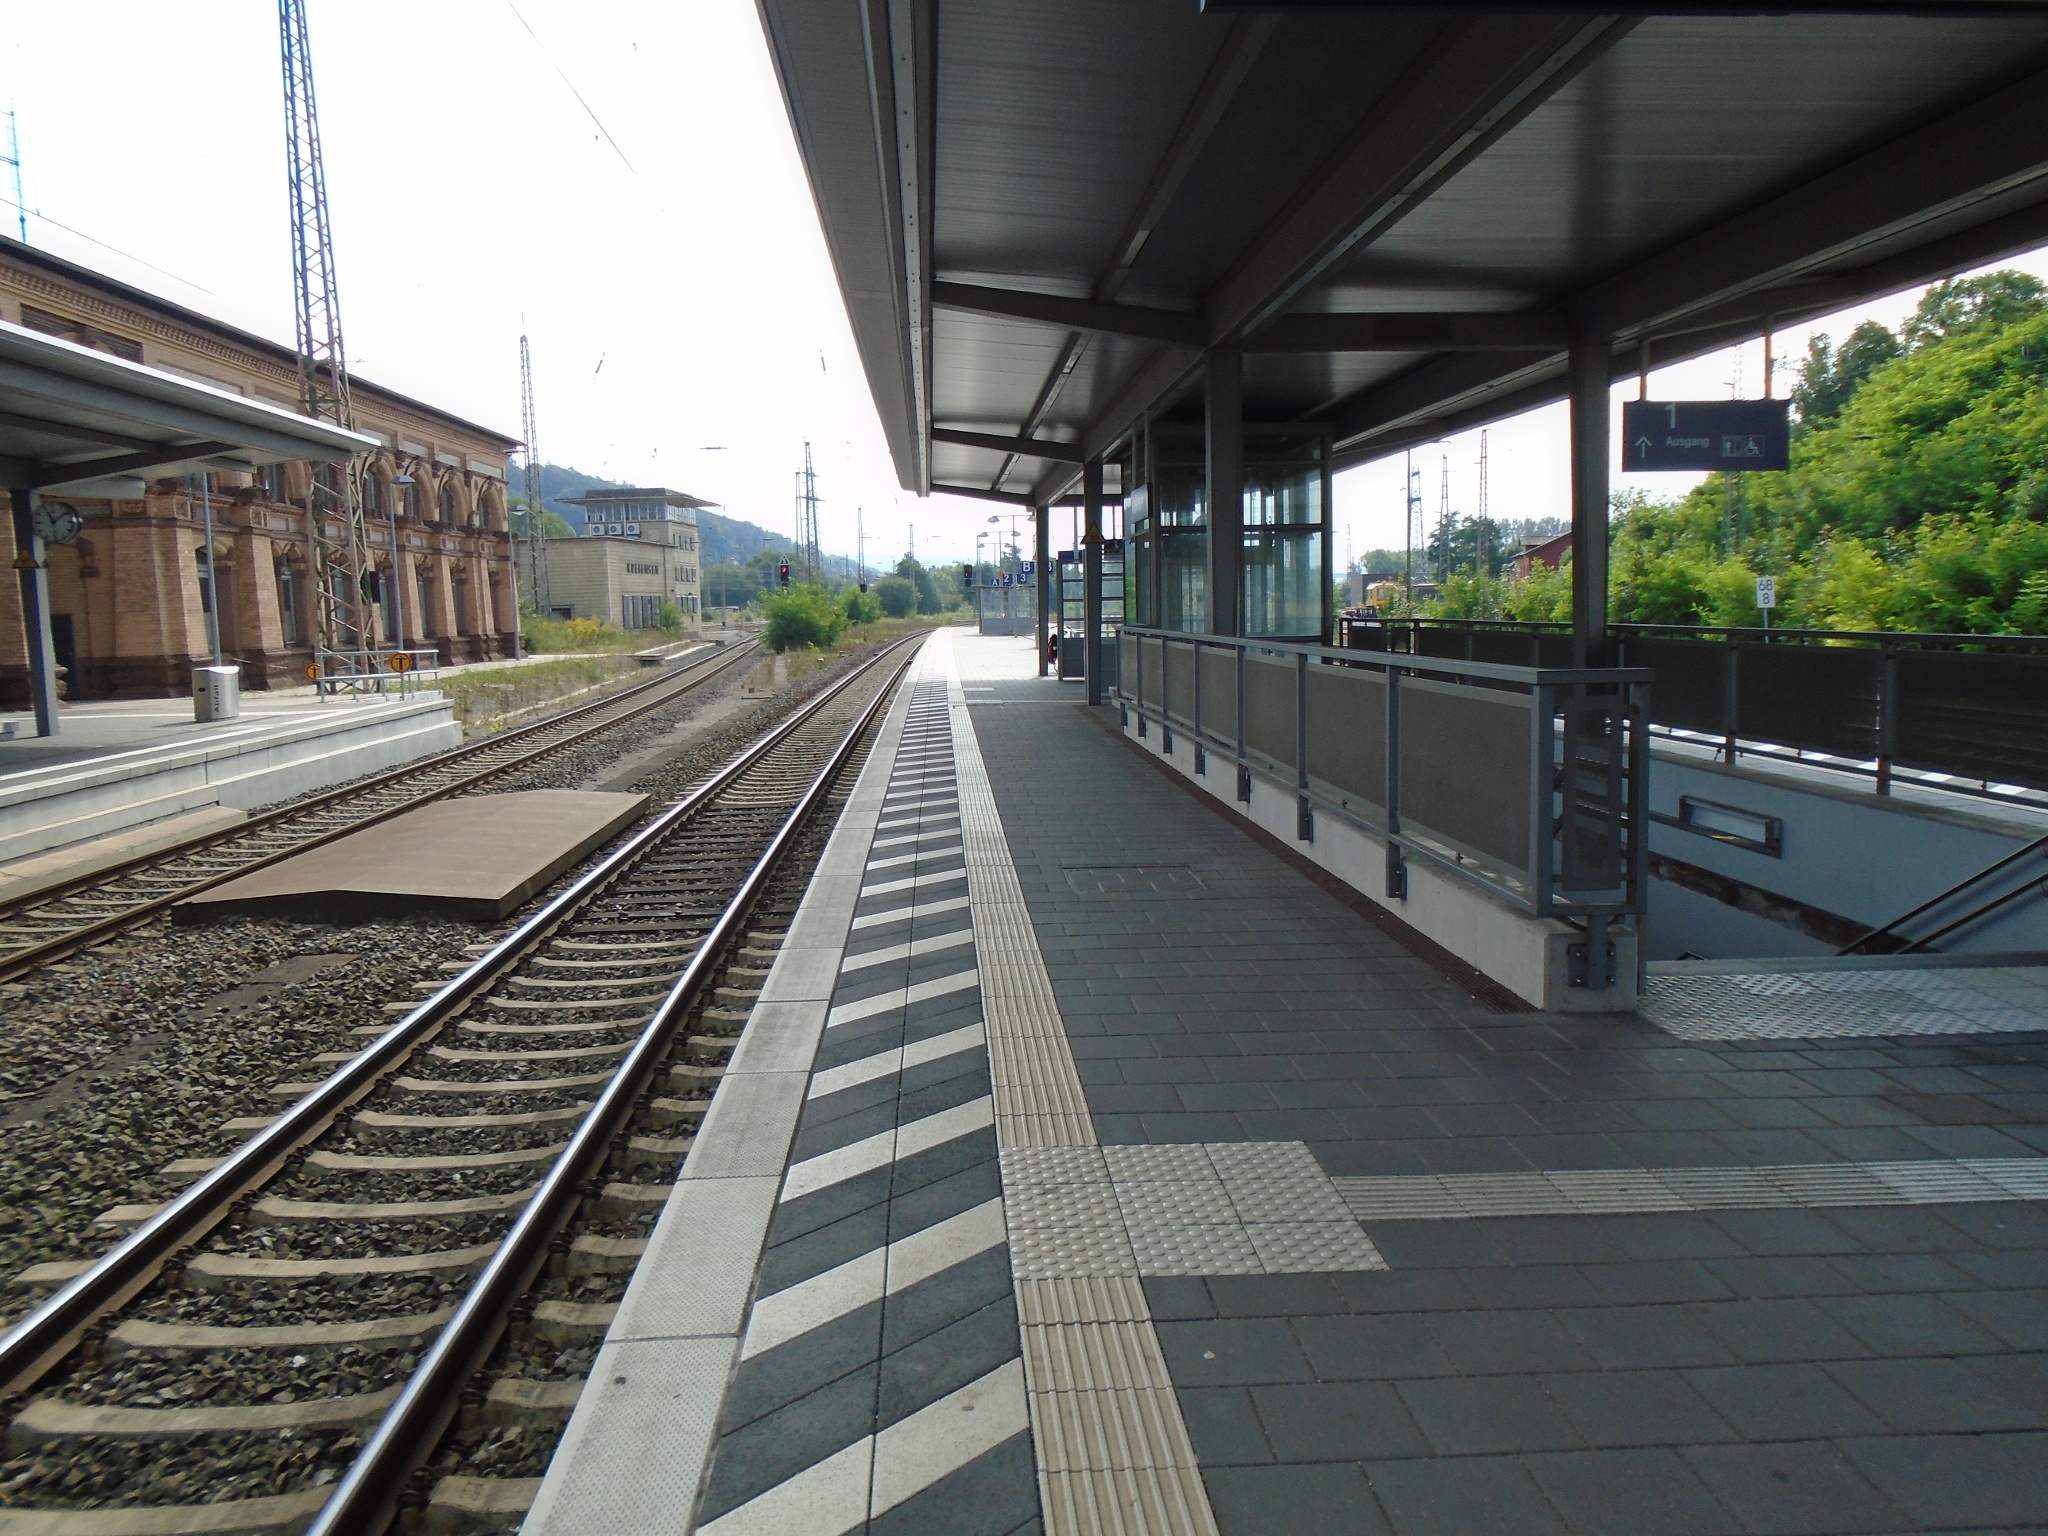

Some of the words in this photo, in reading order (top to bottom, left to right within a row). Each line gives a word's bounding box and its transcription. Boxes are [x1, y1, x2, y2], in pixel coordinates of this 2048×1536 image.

[1665, 402, 1676, 428] 1
[1666, 436, 1710, 448] Ausgang
[1022, 561, 1031, 572] B
[1003, 574, 1010, 583] 2
[1020, 573, 1026, 582] 3
[1759, 579, 1773, 591] 68
[1763, 592, 1770, 605] 8
